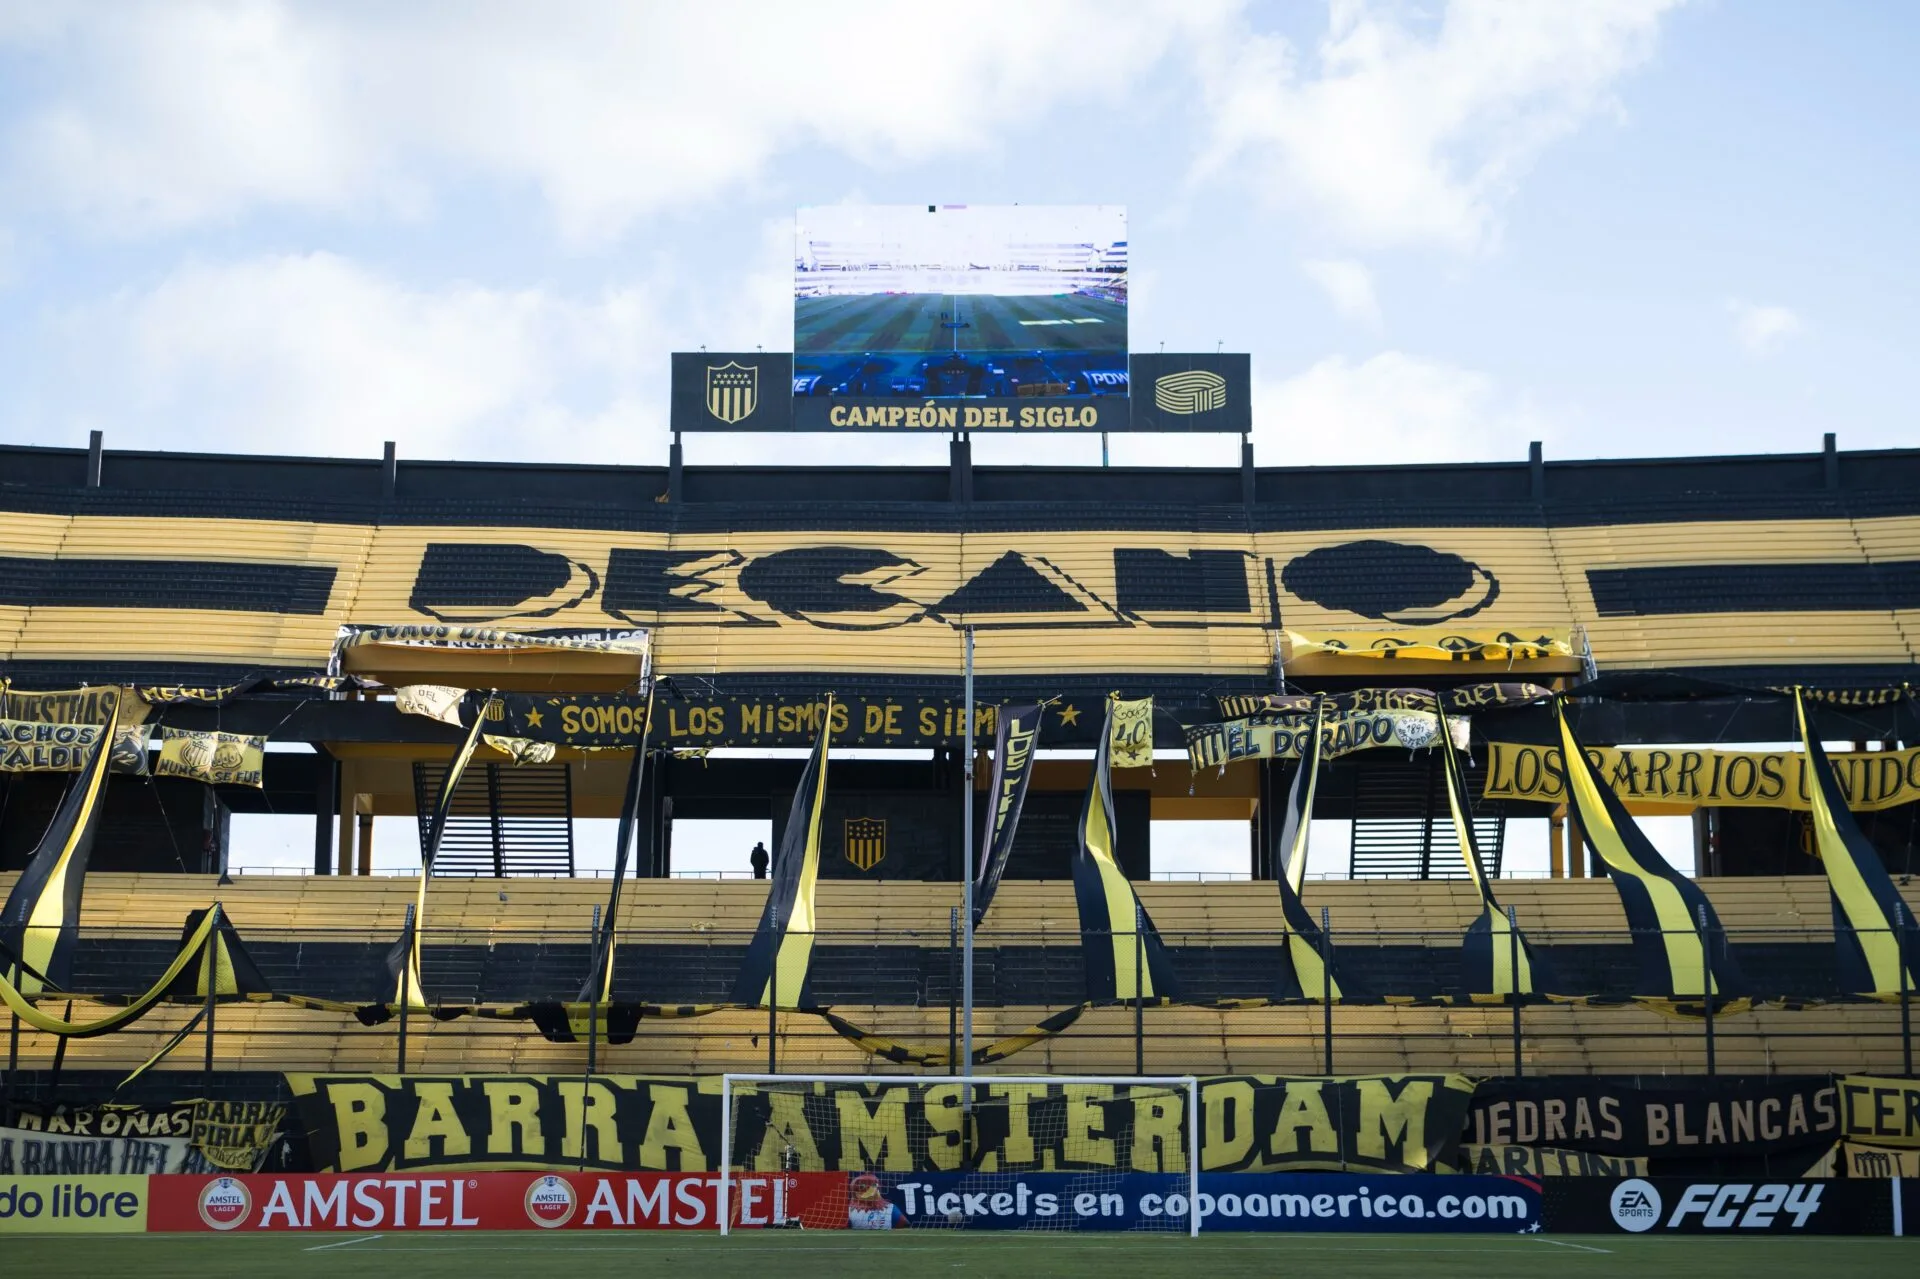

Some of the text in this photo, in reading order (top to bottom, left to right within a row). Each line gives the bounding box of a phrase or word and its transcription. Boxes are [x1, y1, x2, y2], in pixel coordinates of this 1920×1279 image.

[830, 400, 1097, 427] CAMPEÓN DEL SIGLO
[408, 539, 1500, 628] DECANO
[164, 727, 175, 740] LA
[179, 730, 213, 742] BANDA
[561, 705, 653, 734] SOMOS
[669, 706, 725, 737] LOS
[865, 705, 903, 735] DE
[1228, 715, 1395, 757] EL DORADO
[160, 759, 260, 784] NUNCA SE FUE
[1488, 746, 1566, 798] LOS
[329, 1080, 1434, 1173] BARRA AMSTERDAM
[1645, 1087, 1836, 1146] BLANCAS
[52, 1184, 138, 1218] libre
[209, 1195, 241, 1204] AMSTEL
[535, 1193, 567, 1202] AMSTEL
[896, 1182, 1527, 1226] Tickets en copaamerica.com
[1619, 1209, 1653, 1217] SPORTS
[1620, 1191, 1652, 1208] EA
